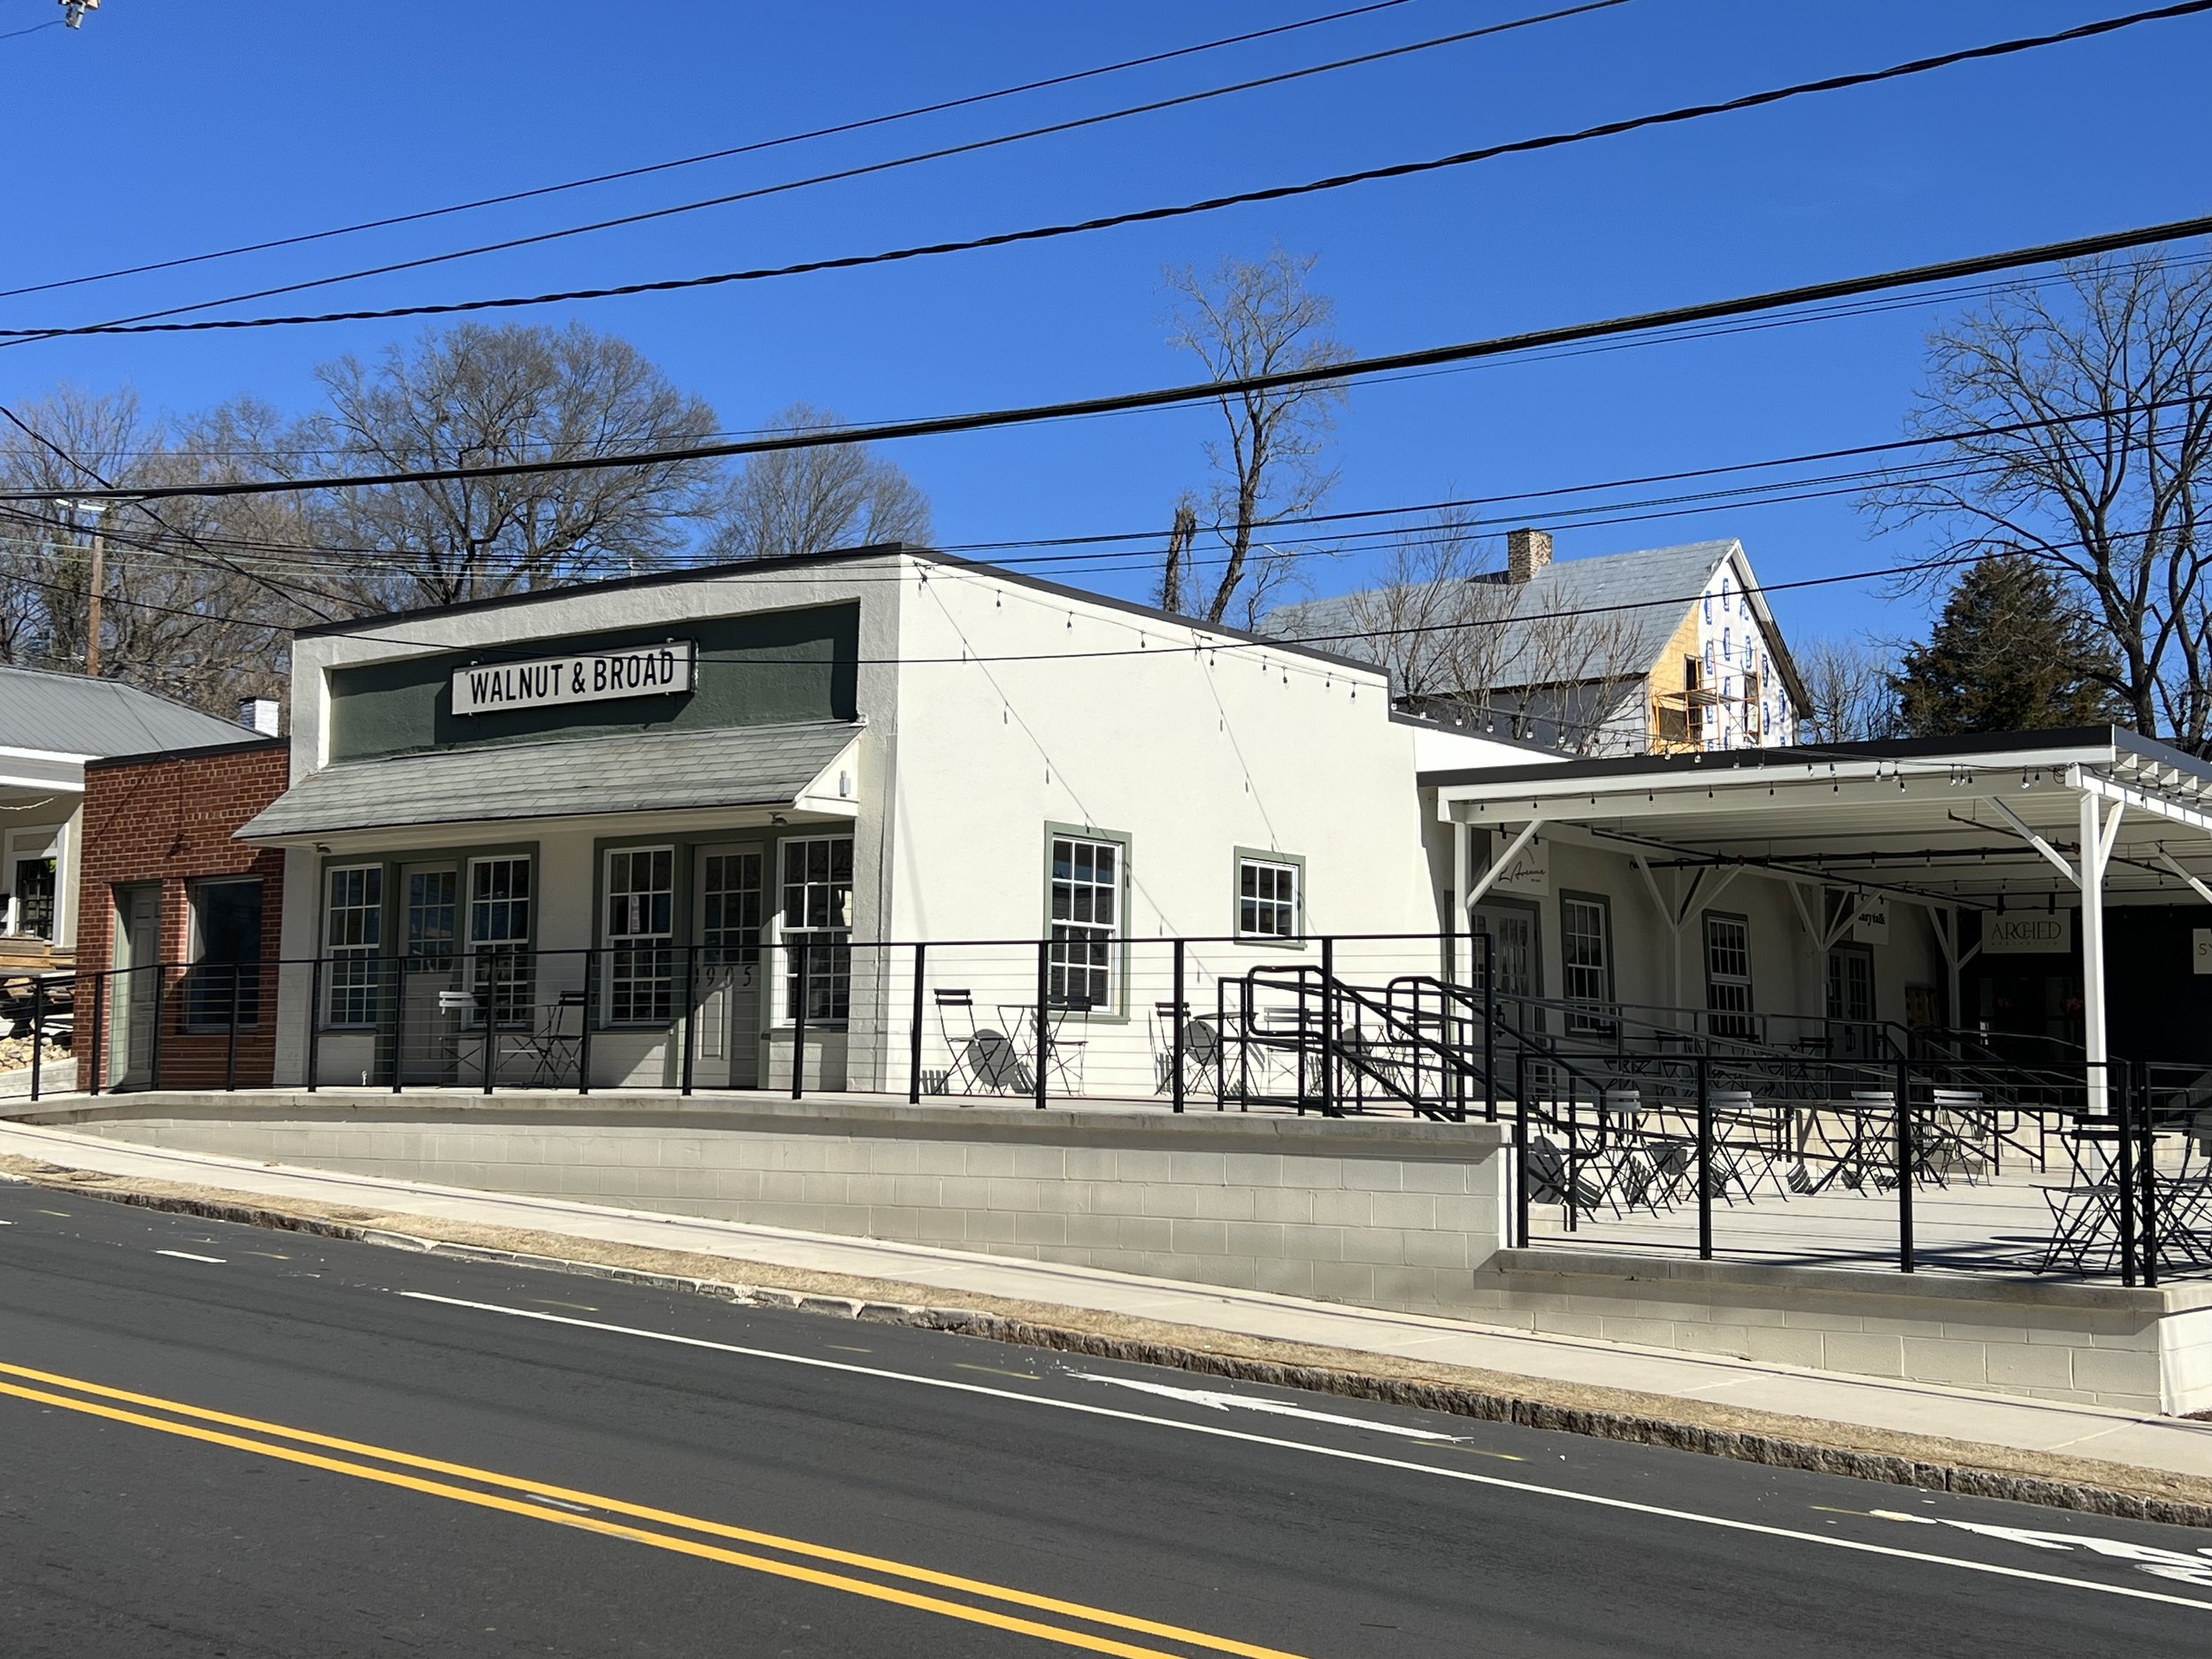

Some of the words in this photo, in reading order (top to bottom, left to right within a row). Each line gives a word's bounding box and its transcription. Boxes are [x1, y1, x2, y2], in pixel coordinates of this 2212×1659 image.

[470, 664, 564, 705] WALNUT
[572, 661, 587, 695] &
[593, 651, 674, 692] BROAD
[1992, 921, 2062, 940] ARCHED
